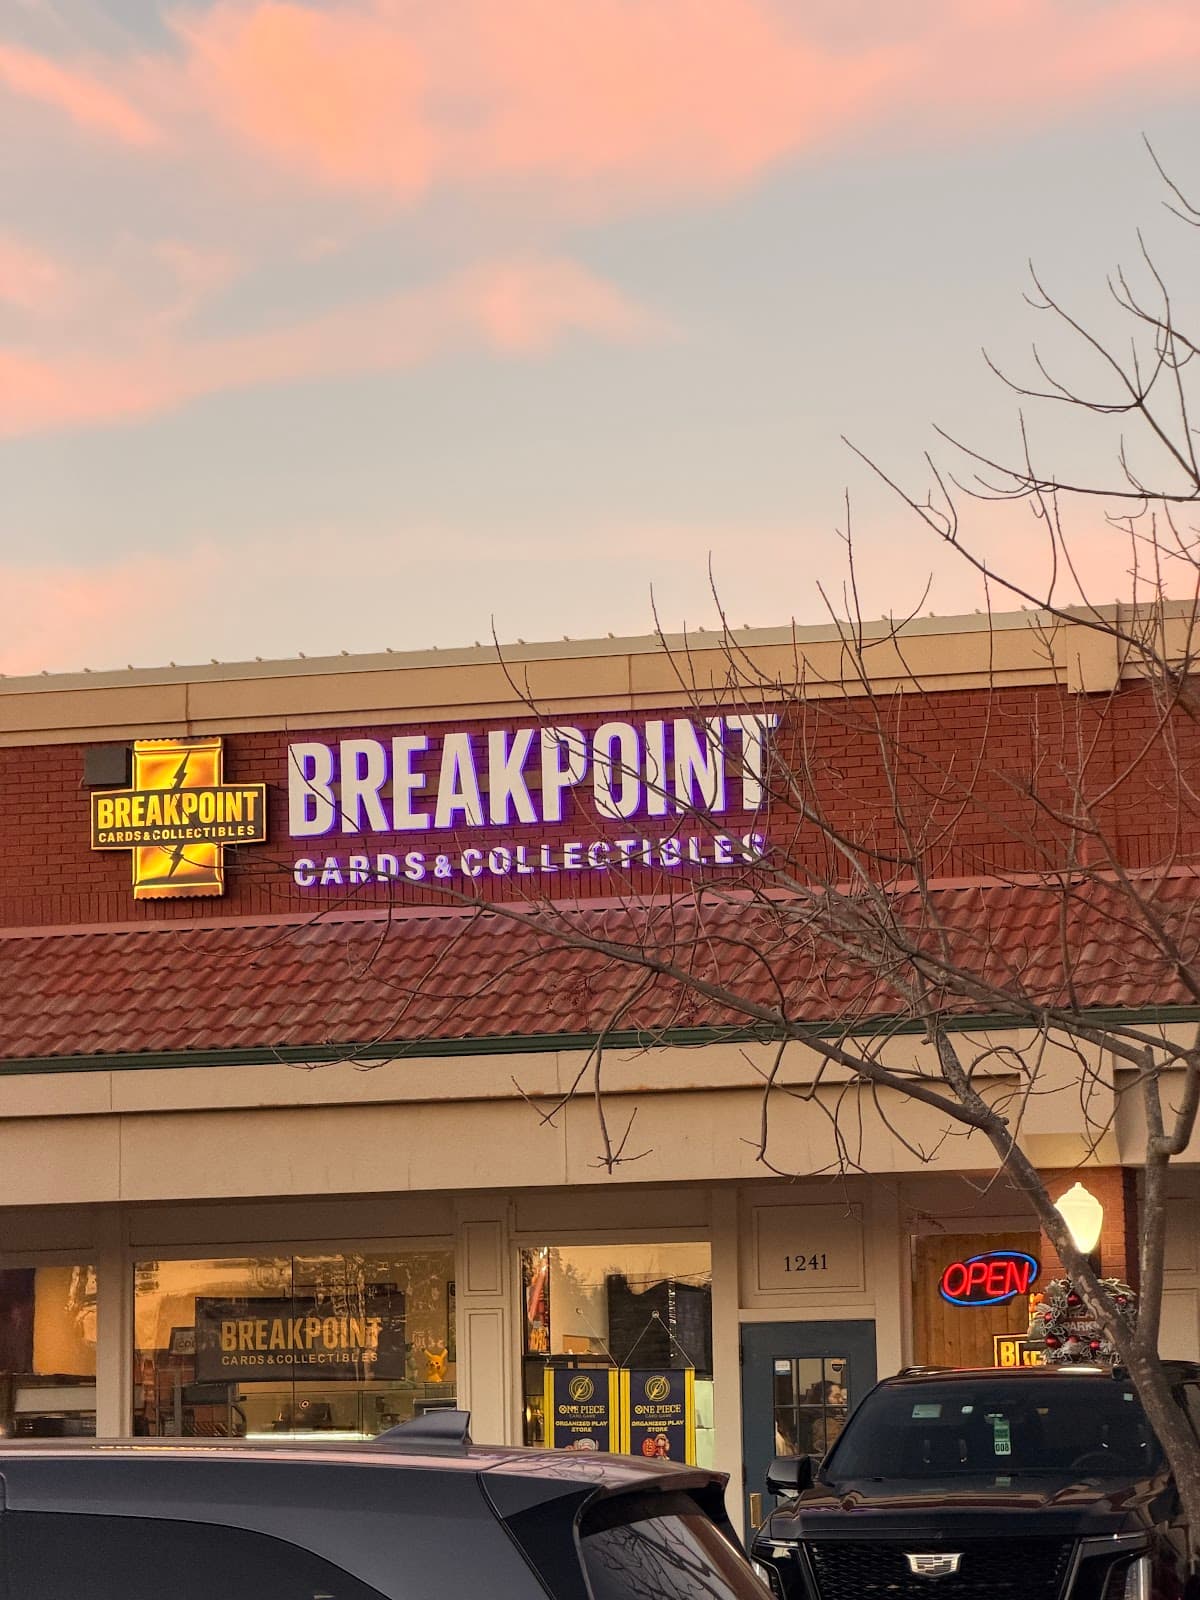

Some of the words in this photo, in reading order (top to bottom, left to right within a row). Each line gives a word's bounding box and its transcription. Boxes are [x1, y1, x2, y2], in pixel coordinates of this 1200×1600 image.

[287, 713, 778, 837] BREAKPOINT
[97, 791, 259, 830] BREAKPOINT
[783, 1253, 829, 1272] 1241
[942, 1261, 1030, 1297] OPEN
[221, 1316, 382, 1352] BREAKPOINT
[558, 1404, 580, 1415] ONE
[580, 1404, 605, 1415] PIECE
[634, 1404, 656, 1415] ONE
[656, 1403, 682, 1414] PIECE
